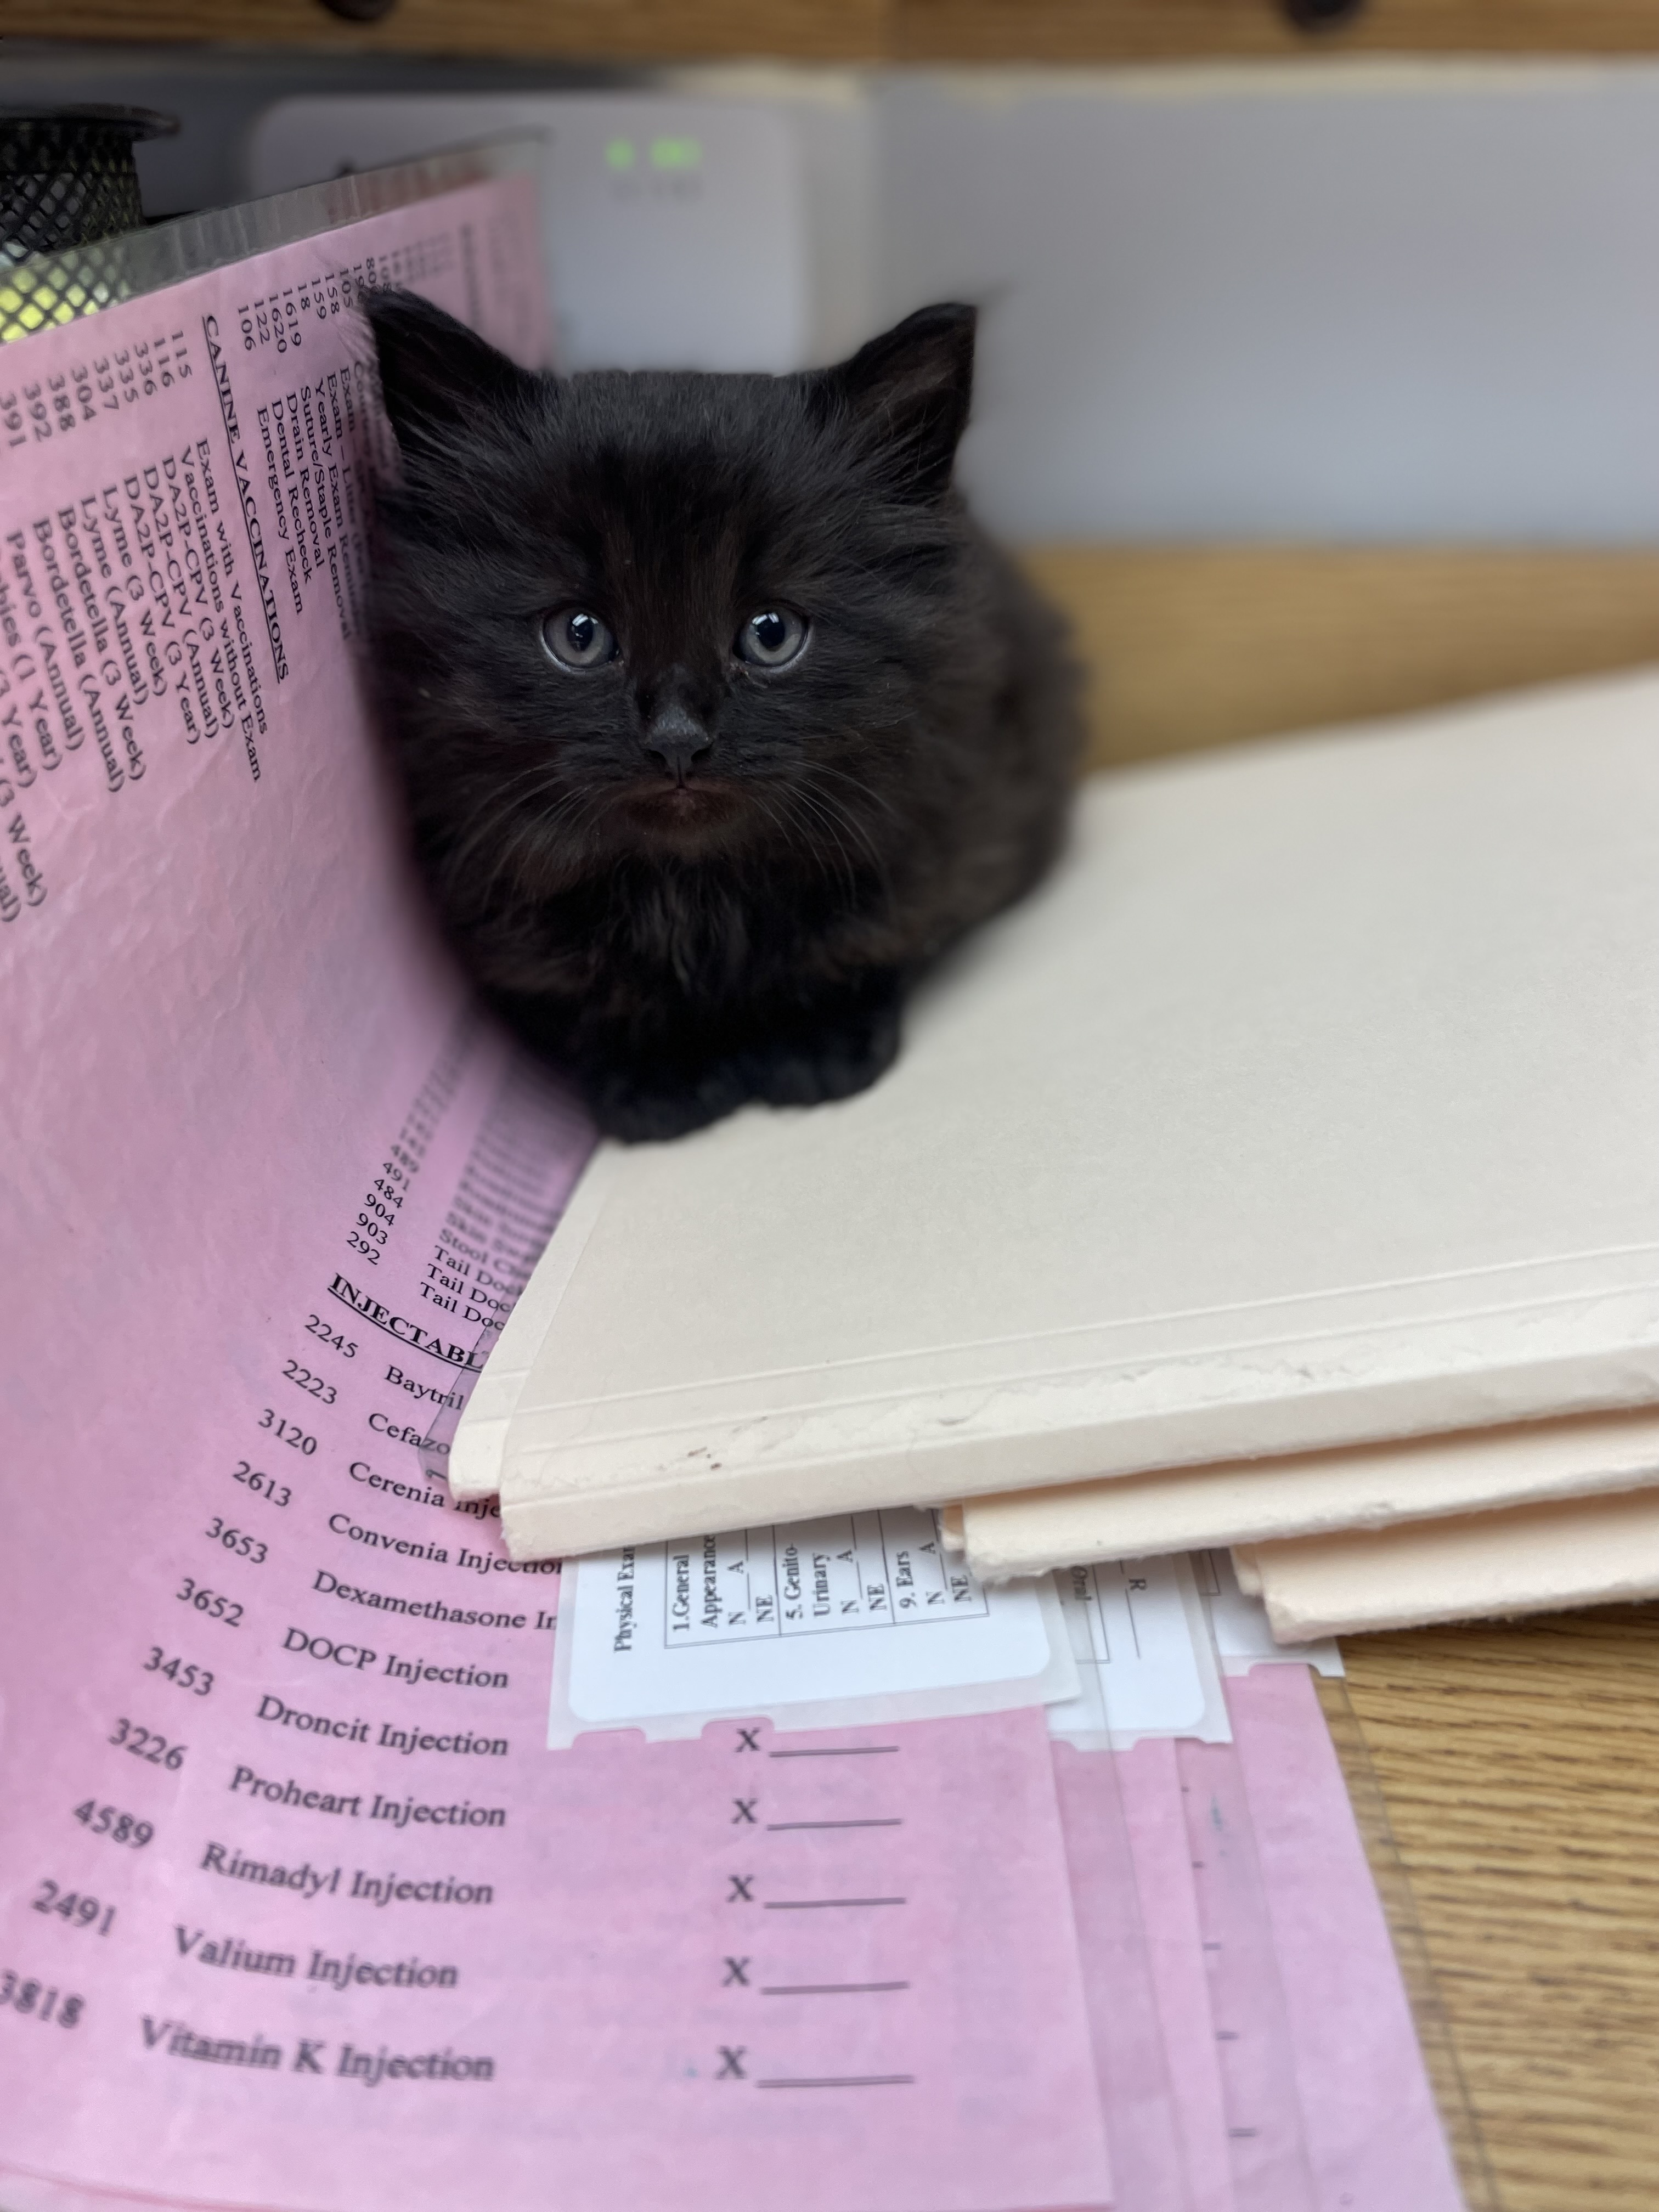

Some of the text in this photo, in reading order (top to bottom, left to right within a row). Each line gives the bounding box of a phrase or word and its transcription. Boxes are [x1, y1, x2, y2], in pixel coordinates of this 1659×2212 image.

[283, 287, 302, 347] 1619
[298, 283, 311, 311] 18
[311, 277, 326, 319] 159
[325, 273, 340, 314] 158
[340, 268, 353, 308] 105
[238, 305, 256, 351] 106
[255, 299, 270, 345] 122
[269, 294, 287, 353] 1620
[94, 357, 119, 410] 337
[114, 349, 139, 403] 335
[134, 342, 157, 396] 336
[154, 337, 175, 388] 116
[172, 330, 192, 379] 115
[0, 392, 27, 448] 391
[22, 383, 52, 442] 392
[47, 374, 76, 432] 388
[70, 366, 97, 421] 304
[328, 371, 343, 441] Exam
[340, 365, 356, 432] Exam
[286, 391, 325, 568] Drain Removal
[315, 377, 332, 457] Yearly
[329, 464, 343, 528] Exam
[202, 314, 290, 684] CANINE VACCINATIONS
[257, 405, 303, 616] Emergency Exam
[272, 397, 312, 585] Dental Recheck
[301, 385, 351, 641] Suture/Staple Removal
[81, 494, 149, 705] Lyme (Annual)
[103, 483, 168, 696] Lyme (3 Week)
[181, 445, 262, 783] Vaccinations without Exam
[196, 437, 268, 735] Exam with Vaccinations
[7, 528, 86, 751] Parvo (Annual)
[32, 515, 126, 793] Bordetella (Annual)
[57, 504, 148, 781] Bordetella (3 Week)
[164, 641, 183, 665] (3
[174, 670, 201, 745] Year)
[182, 629, 219, 738] (Annual)
[199, 617, 215, 641] (3
[211, 647, 235, 729] Week)
[1, 702, 38, 788] Year)
[29, 687, 63, 771] Year)
[7, 812, 48, 908] Week)
[374, 1179, 404, 1209] 484
[383, 1161, 410, 1192] 491
[357, 1212, 388, 1245] 903
[364, 1193, 396, 1227] 904
[347, 1231, 380, 1266] 292
[435, 1244, 471, 1277] Tail
[420, 1281, 458, 1314] Tail
[427, 1263, 464, 1295] Tail
[469, 1286, 516, 1313] Doc
[304, 1314, 359, 1359] 2245
[327, 1272, 488, 1374] INJECTABL
[281, 1359, 338, 1405] 2223
[384, 1364, 465, 1412] Baytril
[258, 1408, 319, 1456] 3120
[368, 1412, 452, 1456] Cefazo
[231, 1460, 294, 1509] 2613
[348, 1460, 446, 1509] Cerenia
[205, 1516, 270, 1566] 3653
[328, 1512, 449, 1564] Convenia
[175, 1577, 245, 1628] 3652
[311, 1568, 527, 1631] Dexamethasone
[727, 1560, 746, 1627] N A
[812, 1551, 832, 1618] Urinary
[836, 1548, 860, 1615] N A
[867, 1583, 888, 1613] NE
[896, 1550, 918, 1610] 9. Ears
[918, 1540, 946, 1606] N A
[950, 1574, 973, 1604] NE
[1128, 1578, 1147, 1591] R
[614, 1584, 638, 1653] Physical
[755, 1594, 774, 1624] NE
[142, 1645, 216, 1697] 3453
[280, 1626, 510, 1689] DOCP Injection
[108, 1717, 189, 1773] 3226
[255, 1694, 510, 1756] Droncit Injection
[72, 1798, 156, 1849] 4589
[228, 1764, 508, 1829] Proheart Injection
[199, 1840, 495, 1907] Rimadyl Injection
[29, 1878, 118, 1938] 2491
[174, 1923, 460, 1991] Valium Injection
[0, 1970, 86, 2029] 3818
[140, 2013, 496, 2087] Vitamin K Injection
